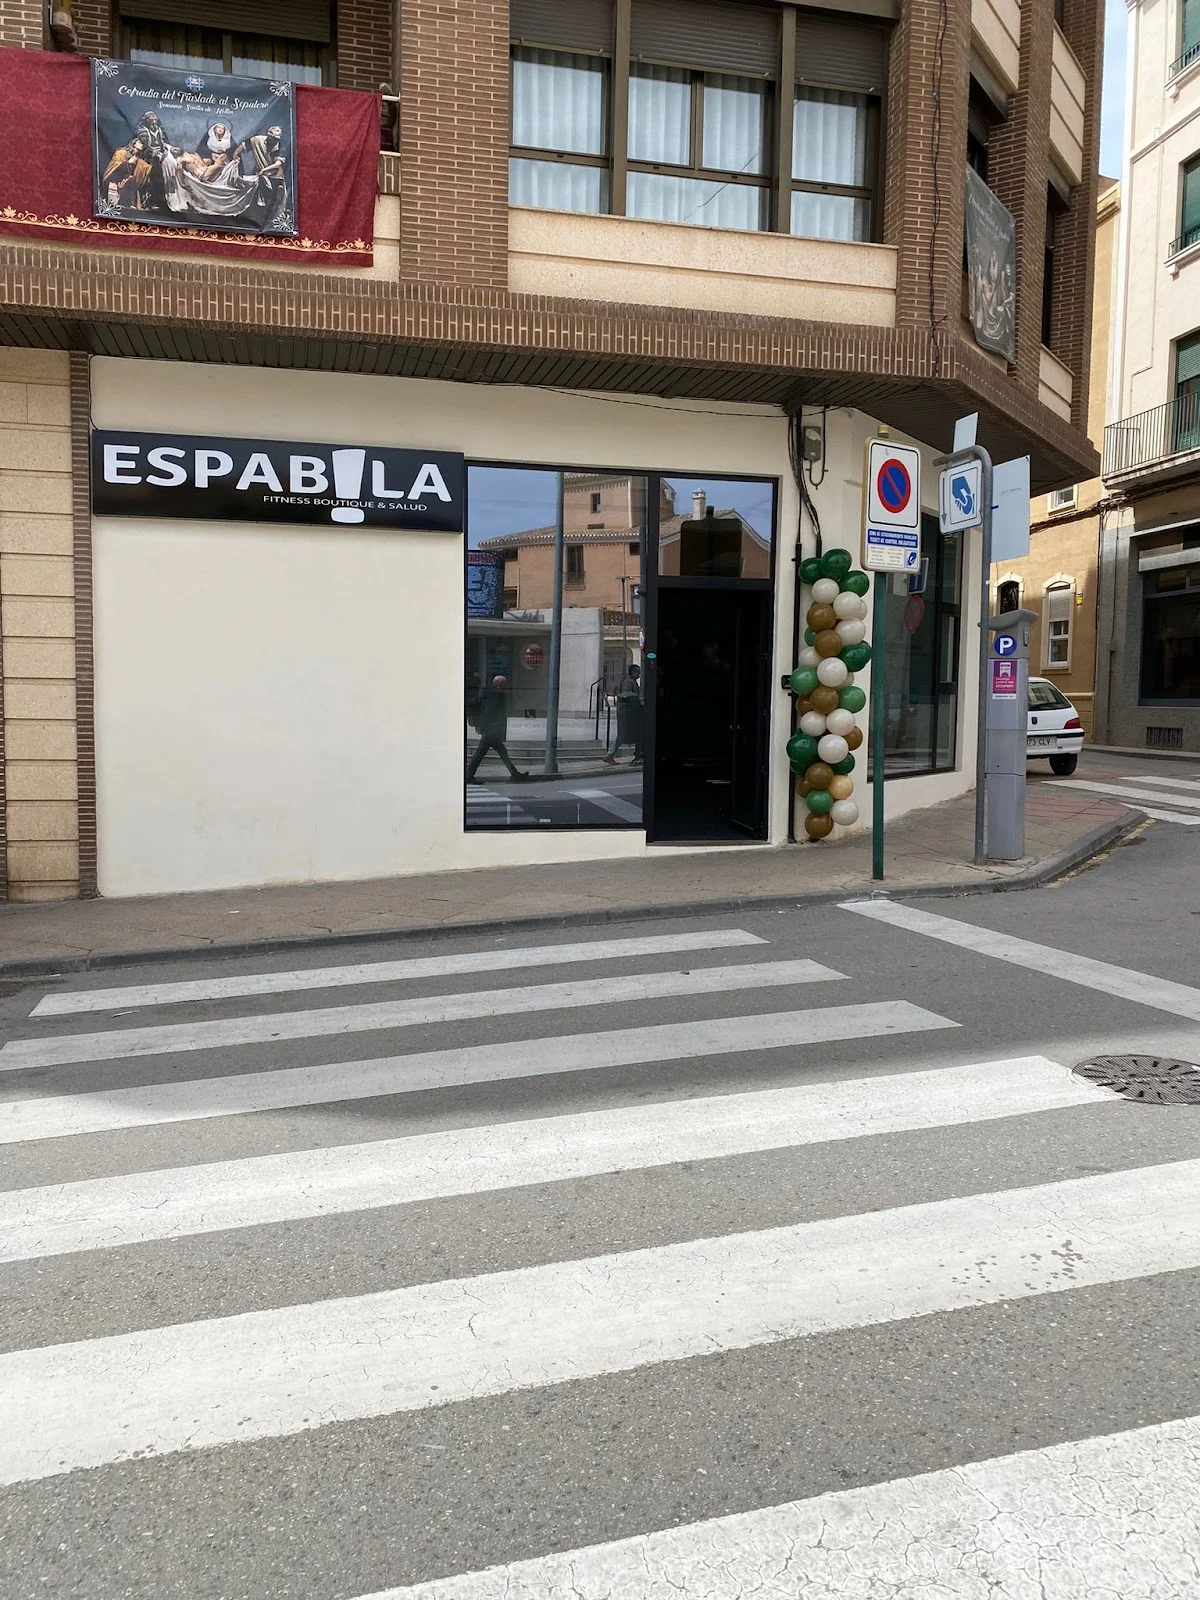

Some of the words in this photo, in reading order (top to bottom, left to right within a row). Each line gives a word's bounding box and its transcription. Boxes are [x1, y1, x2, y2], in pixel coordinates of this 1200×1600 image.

[161, 90, 176, 101] del
[177, 91, 217, 105] Traslado
[218, 96, 229, 106] al
[231, 98, 269, 110] Sepulcro
[263, 495, 311, 505] FITNESS
[313, 498, 375, 509] BOUTIQUE
[388, 502, 428, 511] SALUD
[999, 637, 1013, 654] P
